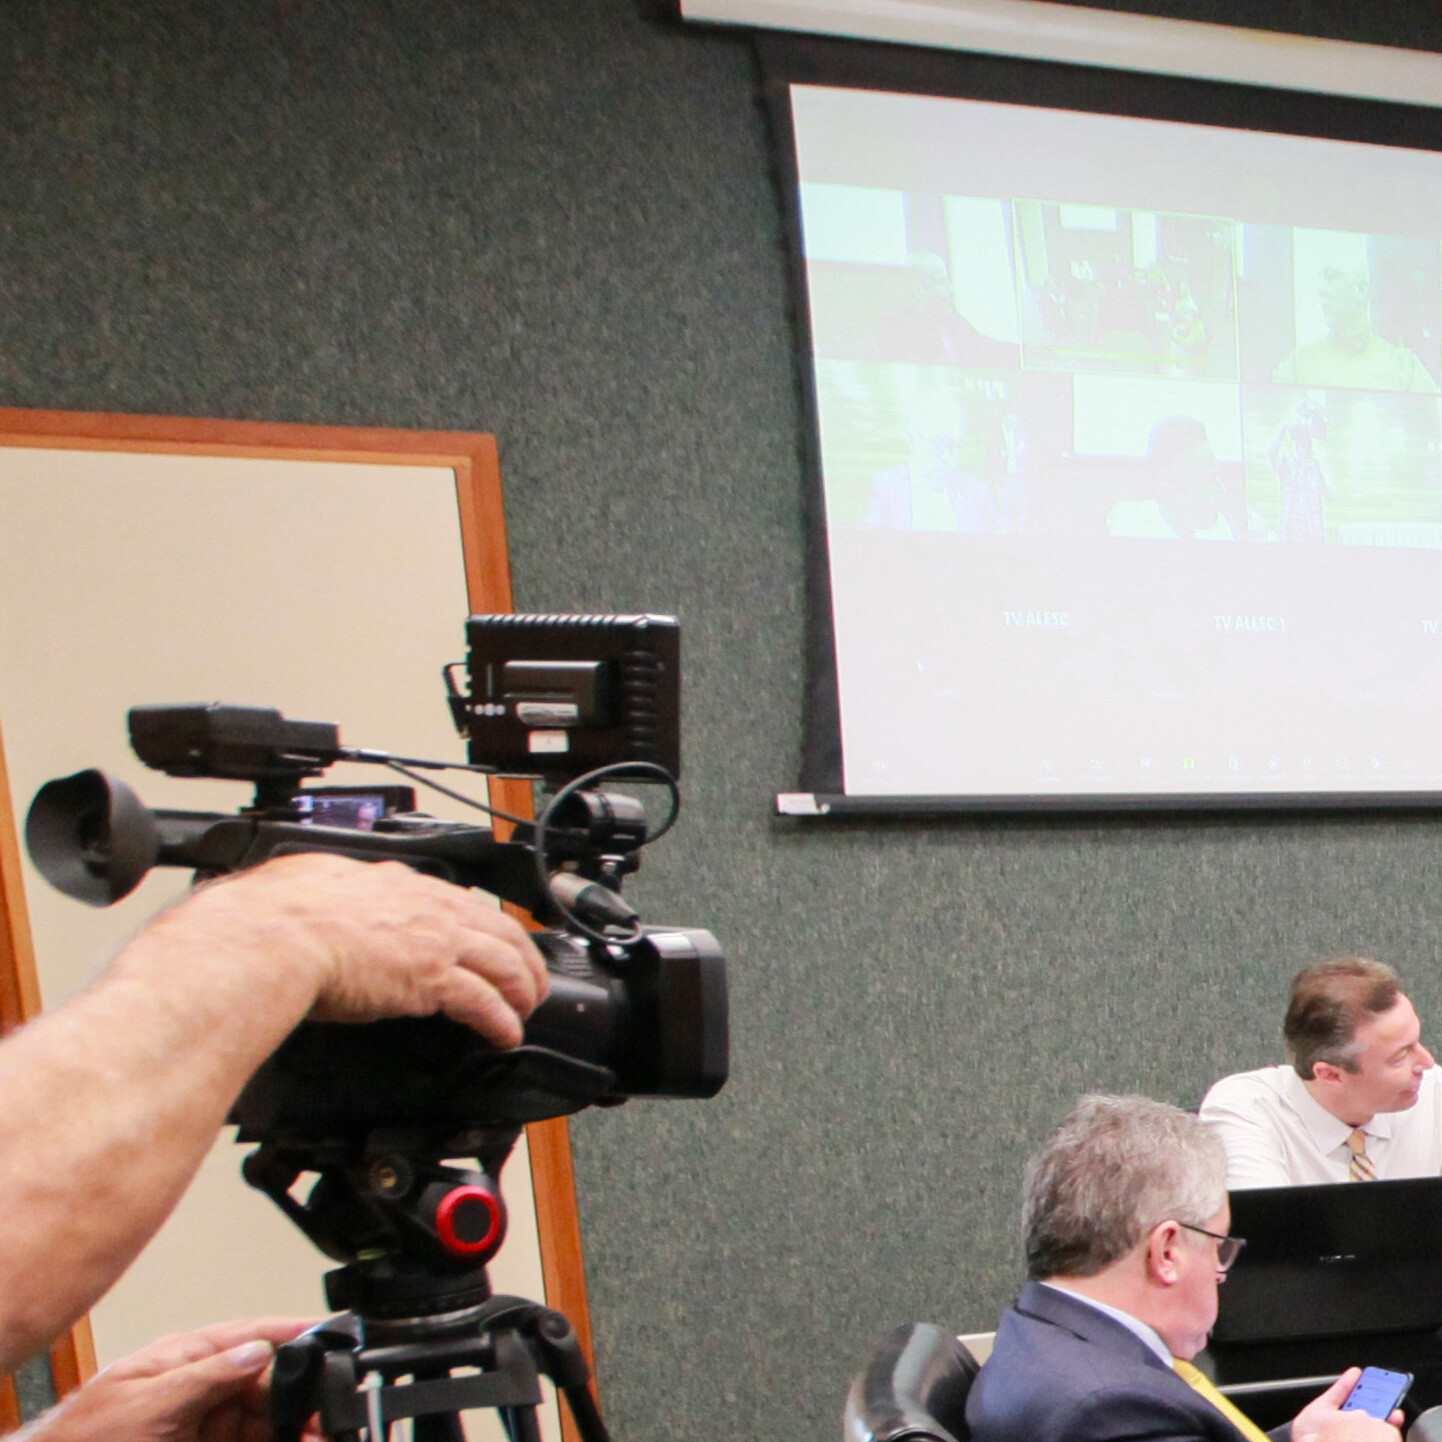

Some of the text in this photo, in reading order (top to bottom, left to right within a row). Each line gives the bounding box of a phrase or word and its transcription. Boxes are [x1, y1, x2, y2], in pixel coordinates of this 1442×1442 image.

[1004, 611, 1069, 628] TV ALESC
[1214, 615, 1232, 630] TV
[1235, 615, 1275, 631] ALESC
[1422, 620, 1440, 635] TV
